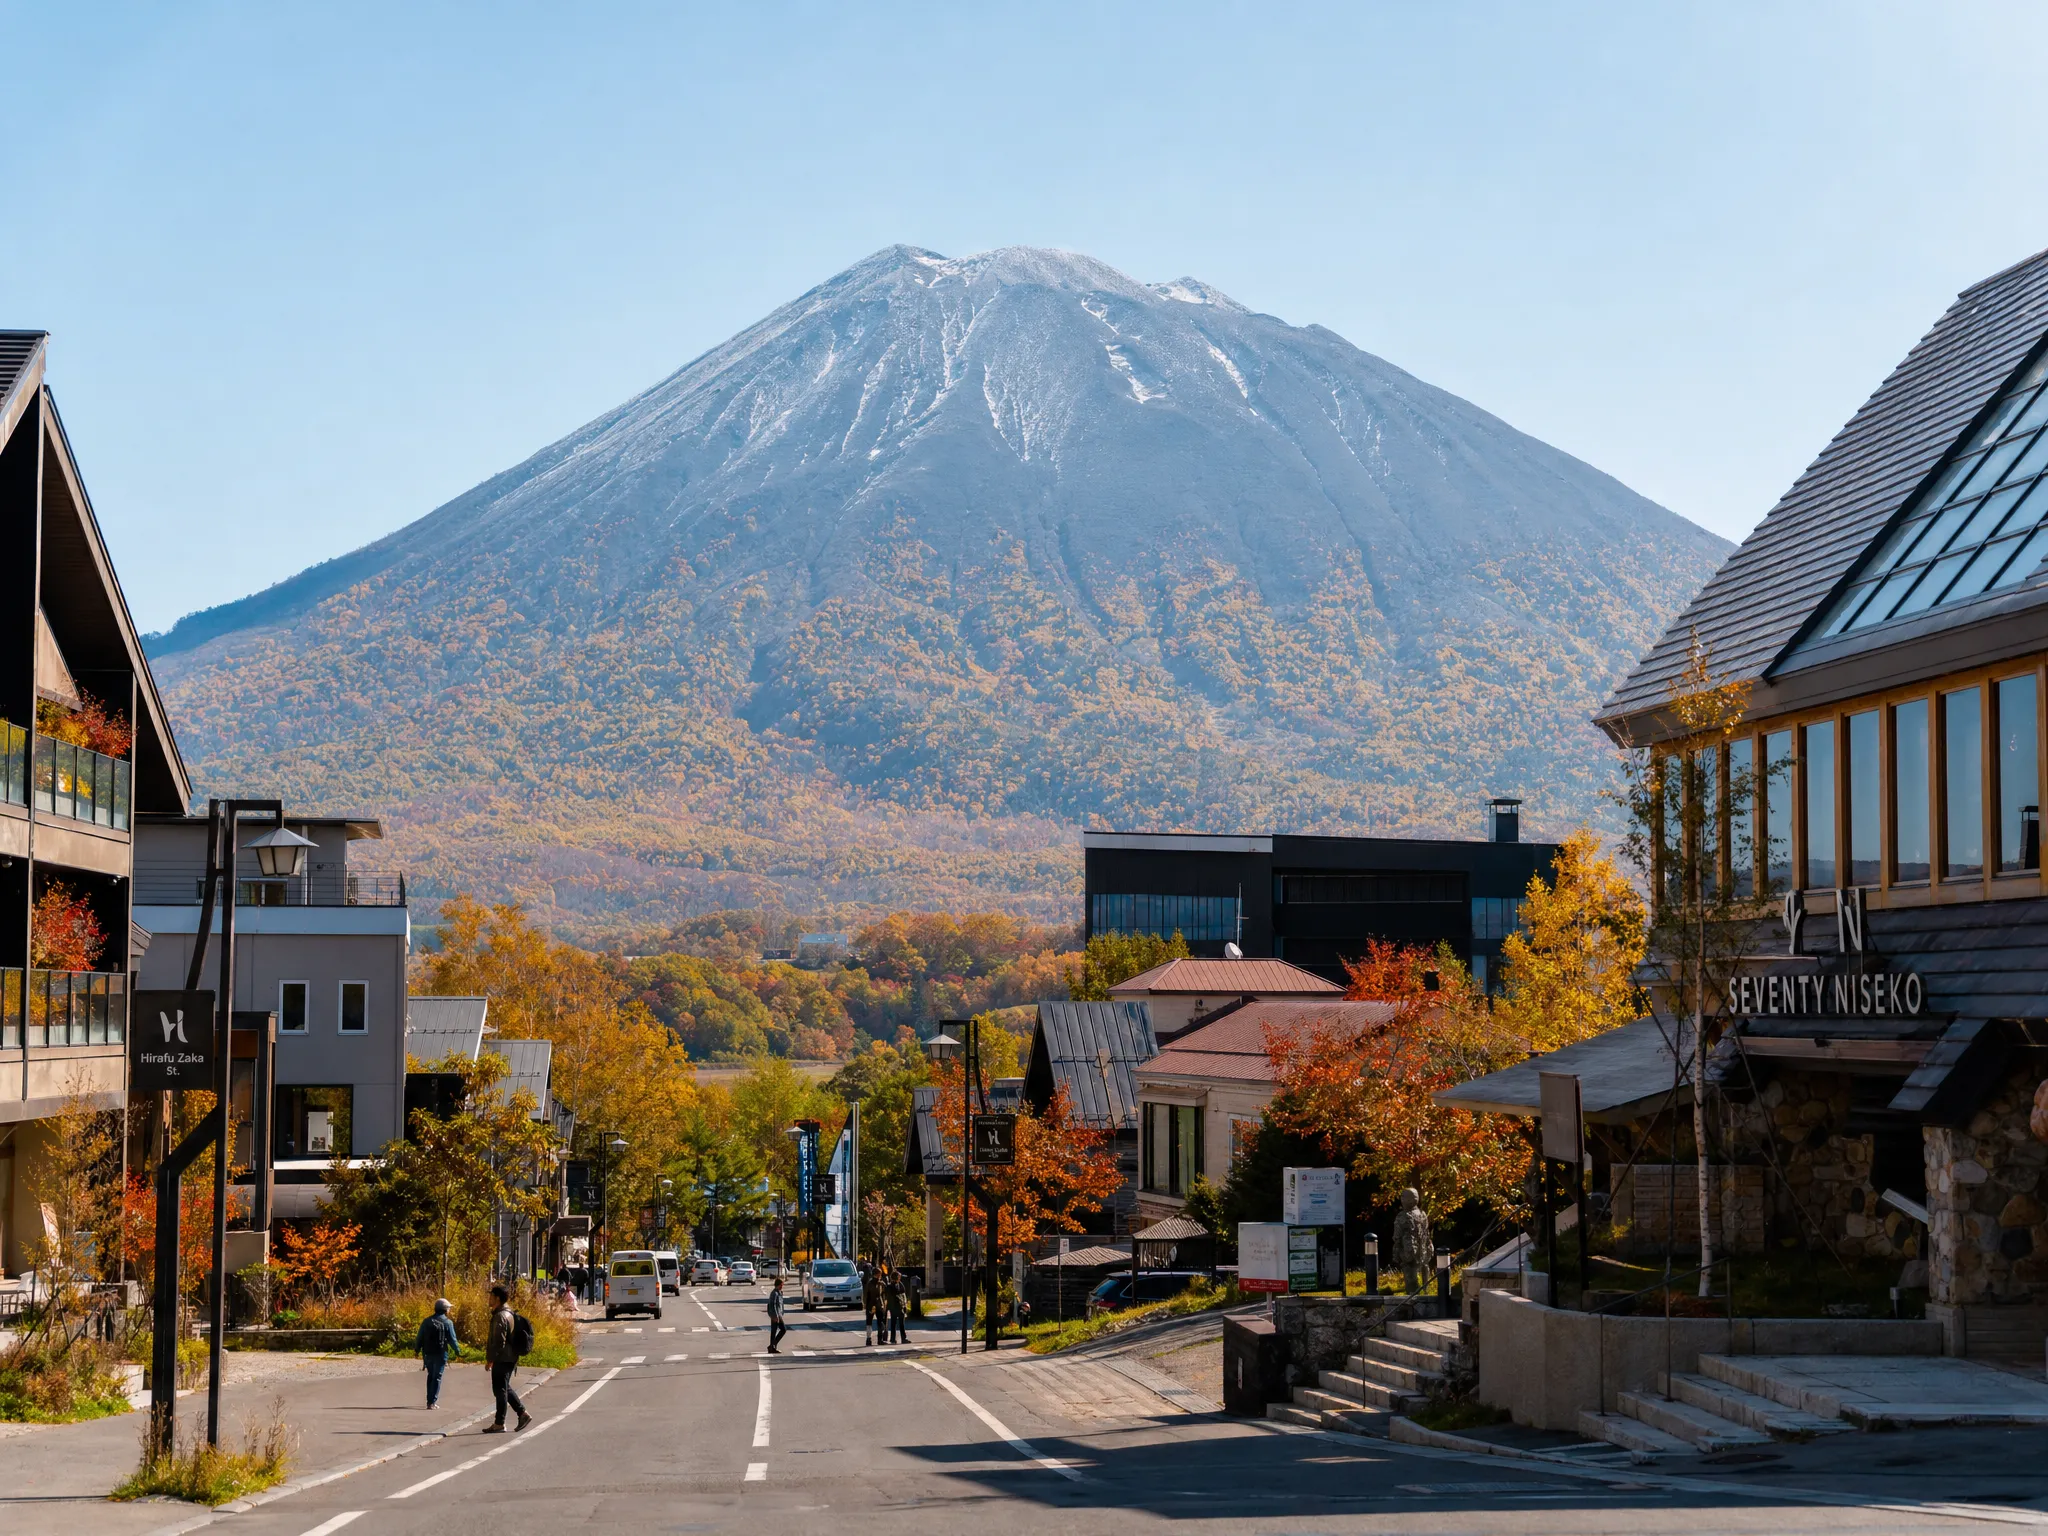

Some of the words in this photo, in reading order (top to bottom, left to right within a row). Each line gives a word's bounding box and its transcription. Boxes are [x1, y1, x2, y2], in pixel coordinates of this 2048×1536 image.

[1729, 974, 1825, 1015] SEVENTY
[1834, 972, 1922, 1015] NISEKO
[140, 1052, 175, 1063] Hirafu
[177, 1052, 204, 1063] Zaka
[166, 1066, 180, 1076] St.
